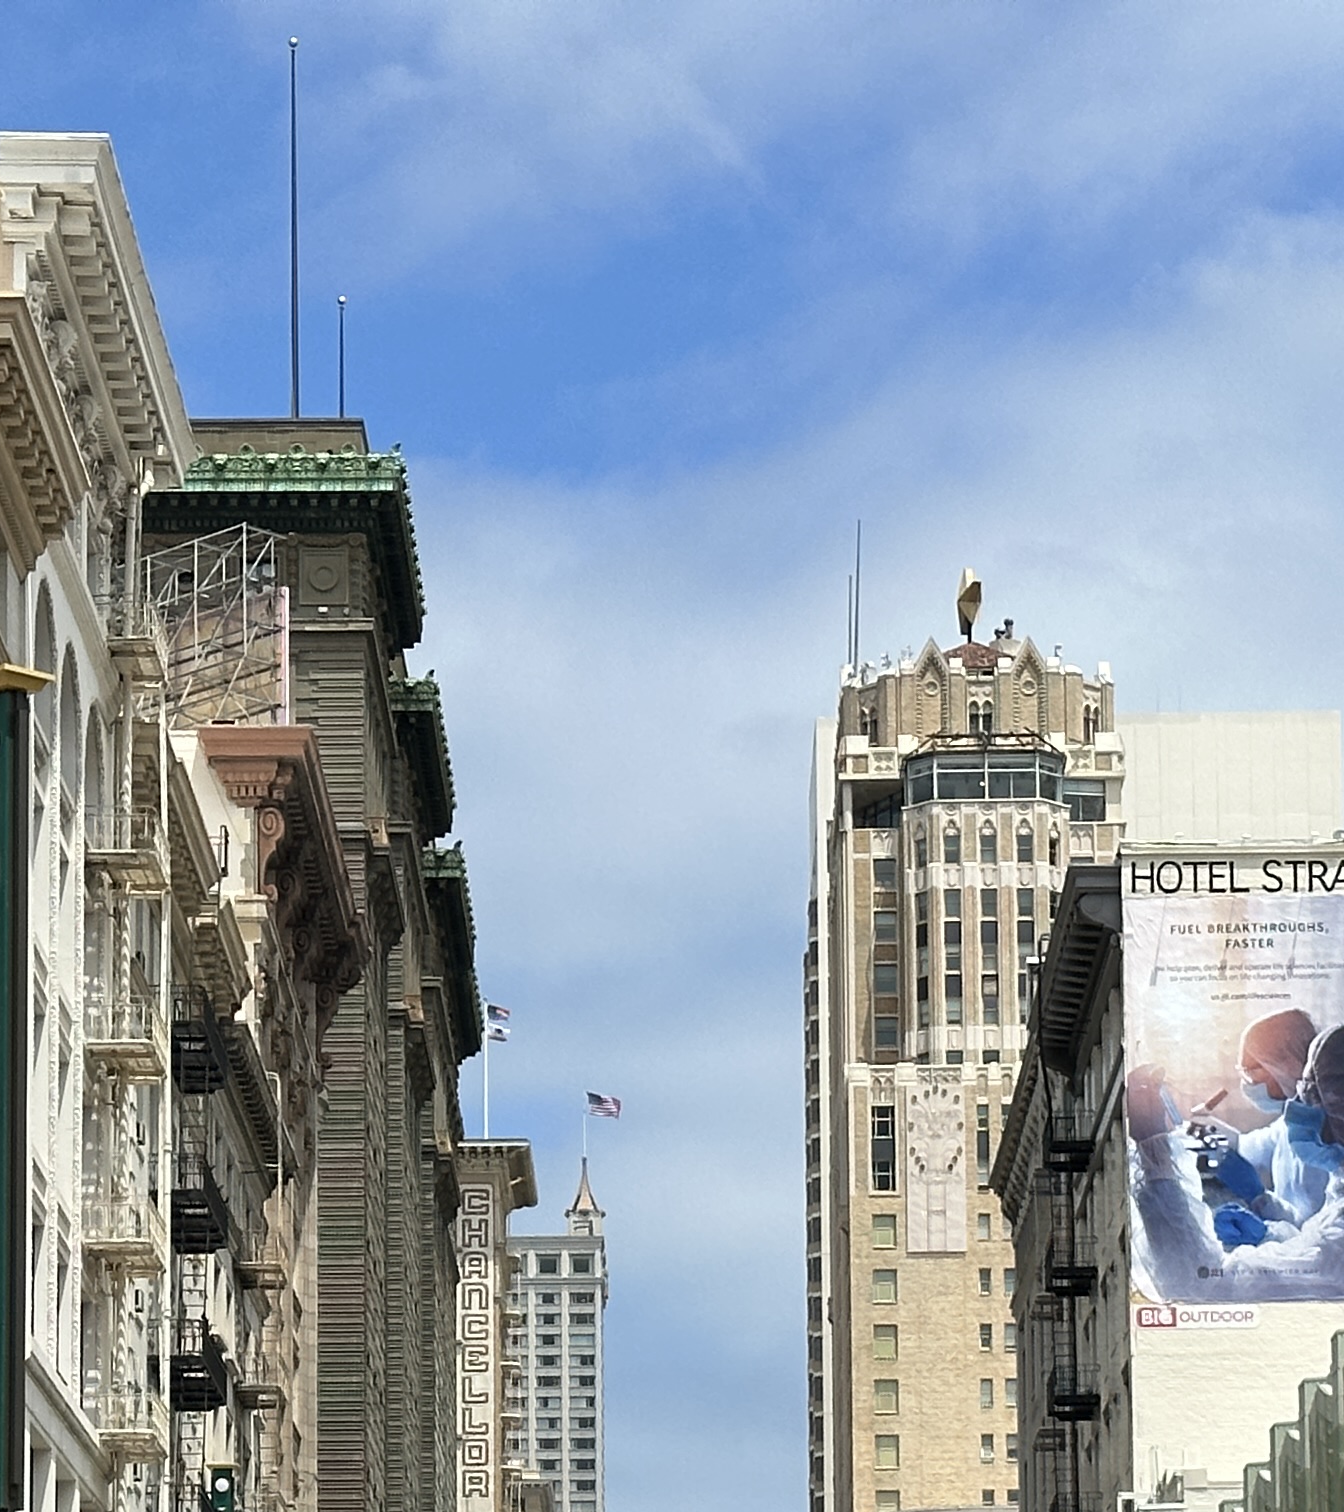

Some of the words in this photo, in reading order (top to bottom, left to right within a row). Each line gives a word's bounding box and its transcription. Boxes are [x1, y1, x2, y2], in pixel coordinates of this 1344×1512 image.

[1131, 860, 1249, 893] HOTEL
[1170, 923, 1202, 935] FUEL
[1207, 922, 1330, 935] BREAKTHROUGHS,
[1225, 938, 1275, 949] FASTER
[1140, 1308, 1173, 1326] BIG
[1179, 1310, 1254, 1323] OUTDOOR
[460, 1188, 491, 1498] CHANCELLOR
